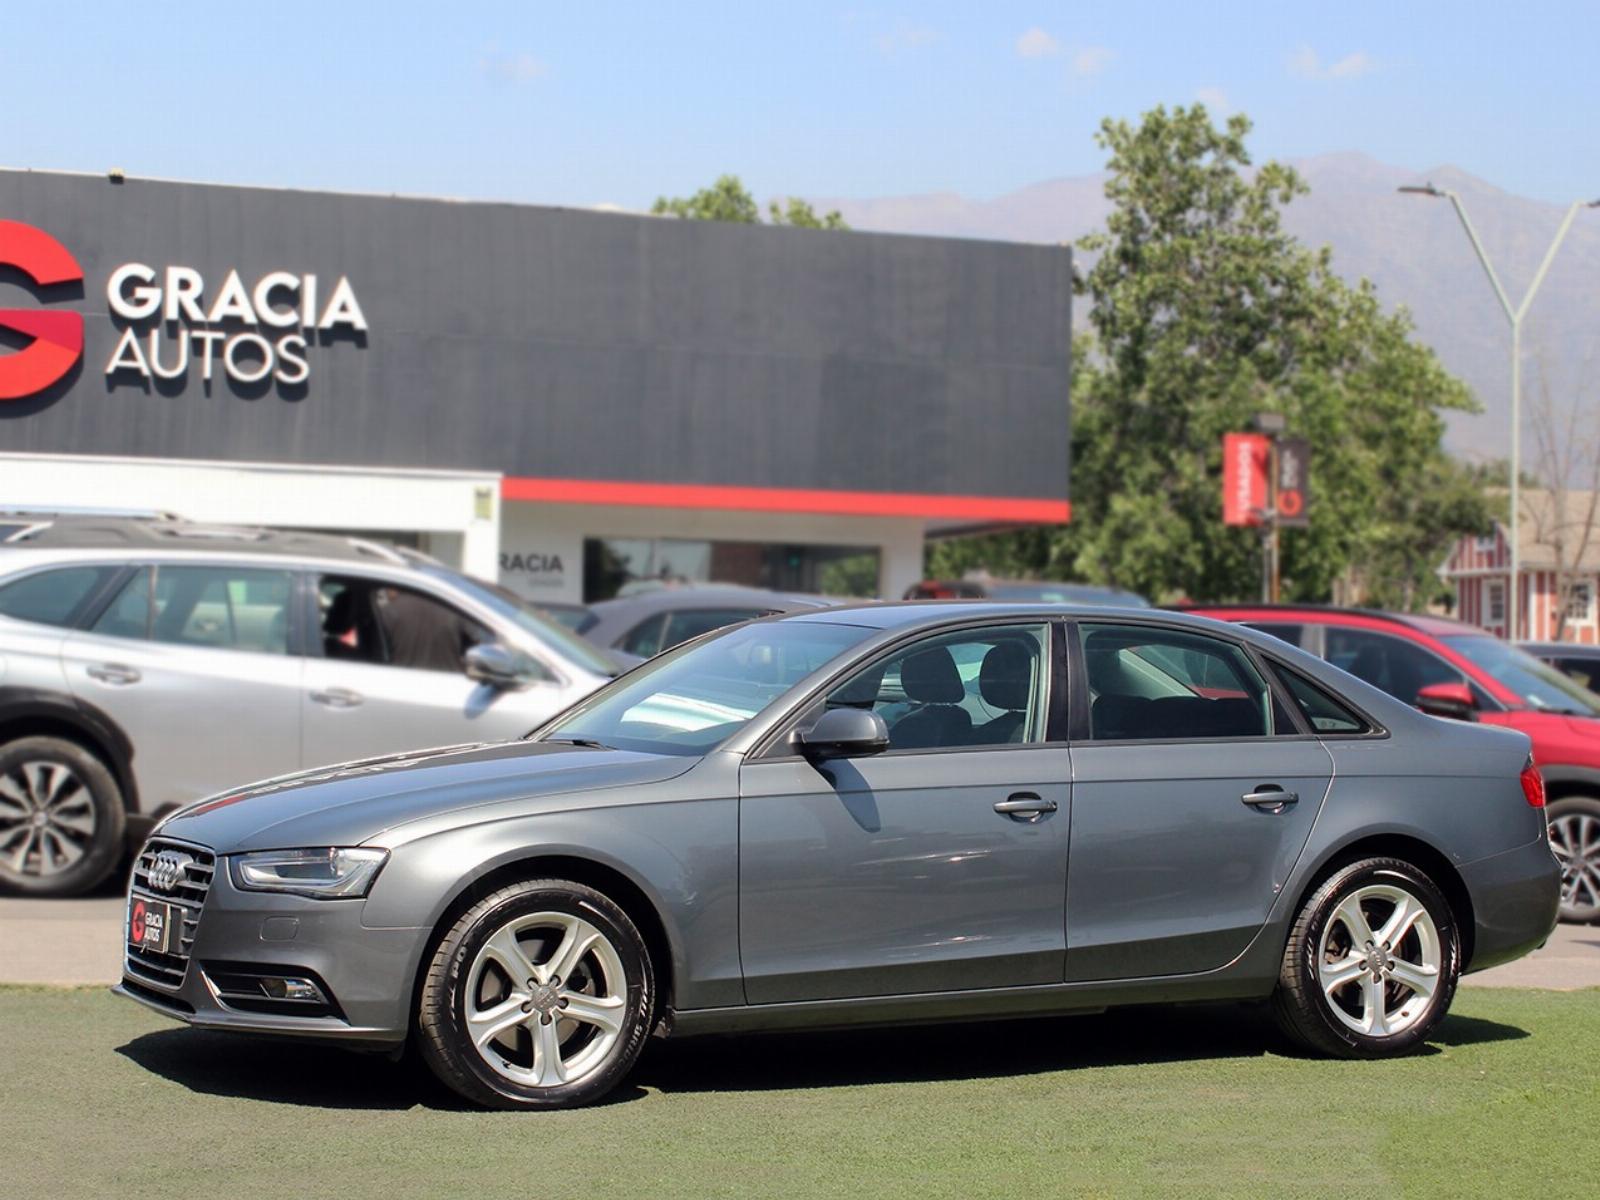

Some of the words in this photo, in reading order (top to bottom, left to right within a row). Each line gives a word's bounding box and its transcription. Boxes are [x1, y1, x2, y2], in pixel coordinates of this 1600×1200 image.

[107, 263, 368, 331] GRACIA
[105, 327, 309, 384] AUTOS
[498, 552, 563, 573] RACIA
